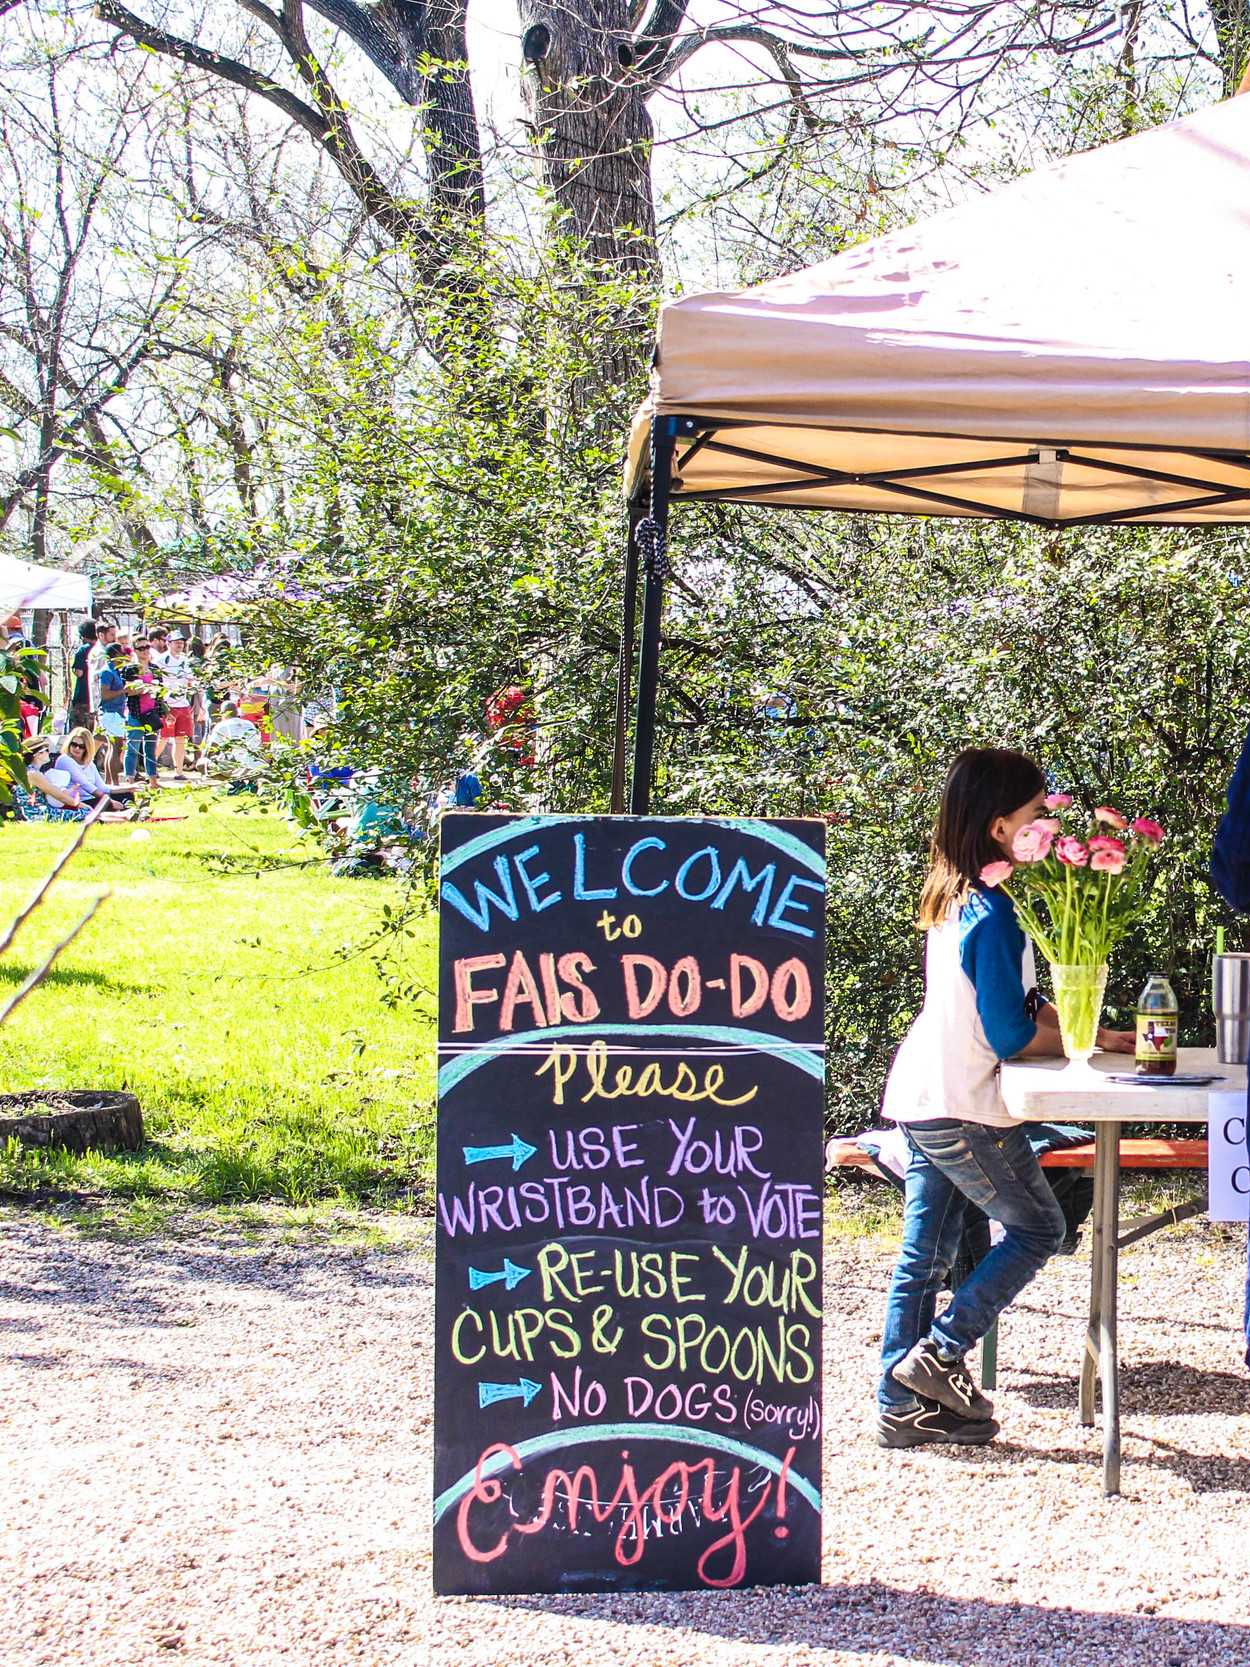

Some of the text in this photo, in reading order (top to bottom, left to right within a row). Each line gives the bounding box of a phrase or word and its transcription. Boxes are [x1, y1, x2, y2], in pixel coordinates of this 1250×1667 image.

[441, 832, 826, 938] WELCOME
[596, 909, 643, 942] to
[452, 950, 812, 1033] FAIS DO-DO
[534, 1040, 758, 1105] Please
[548, 1116, 774, 1179] USE YOUR
[438, 1176, 821, 1240] WRISTBAND to VOTE
[537, 1241, 823, 1318] RE-USE YOUR
[451, 1303, 815, 1385] CUPS & SPOONS
[549, 1365, 821, 1440] NO DOGS (sorry!)
[456, 1441, 797, 1588] Enjoy!
